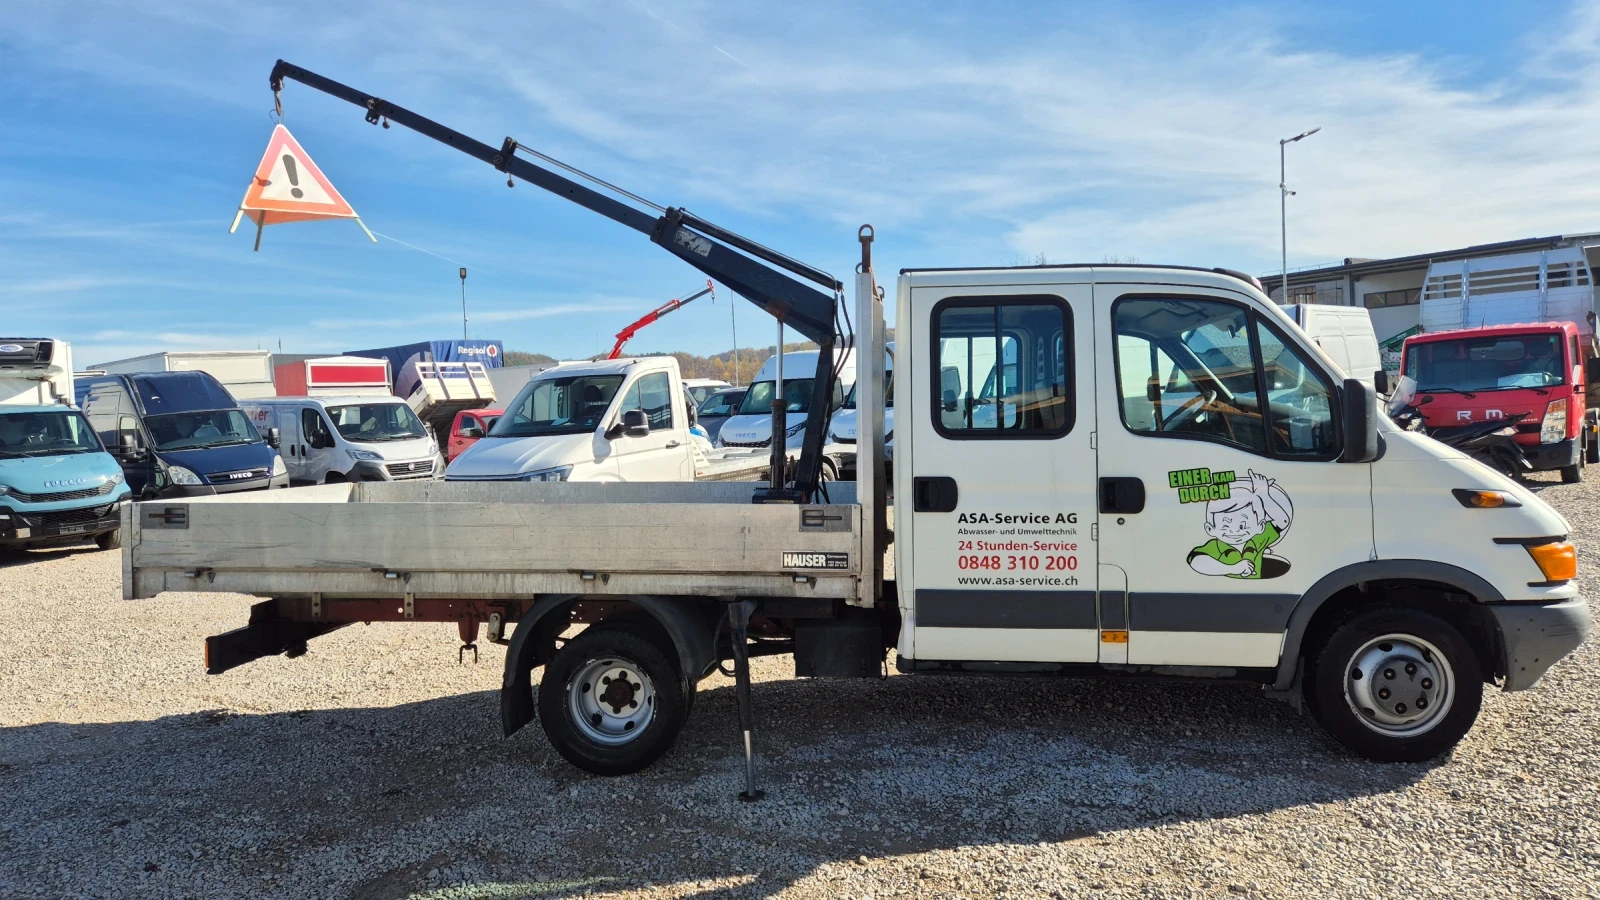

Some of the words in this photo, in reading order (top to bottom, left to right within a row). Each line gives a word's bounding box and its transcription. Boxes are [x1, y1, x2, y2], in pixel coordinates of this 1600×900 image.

[458, 346, 486, 356] Regisol
[43, 478, 86, 488] IVECO
[1169, 468, 1211, 487] EINER
[1212, 471, 1235, 483] KAM
[1179, 484, 1230, 503] DURCH
[957, 512, 1050, 524] ASA-Service
[1055, 512, 1078, 524] AG
[958, 540, 973, 551] 24
[977, 540, 1078, 551] Stunden-Service
[784, 553, 826, 566] HAUSER
[958, 555, 1001, 570] 0848
[1007, 555, 1039, 570] 310
[1045, 555, 1078, 570] 200
[957, 575, 1078, 586] www.asa-service.ch
